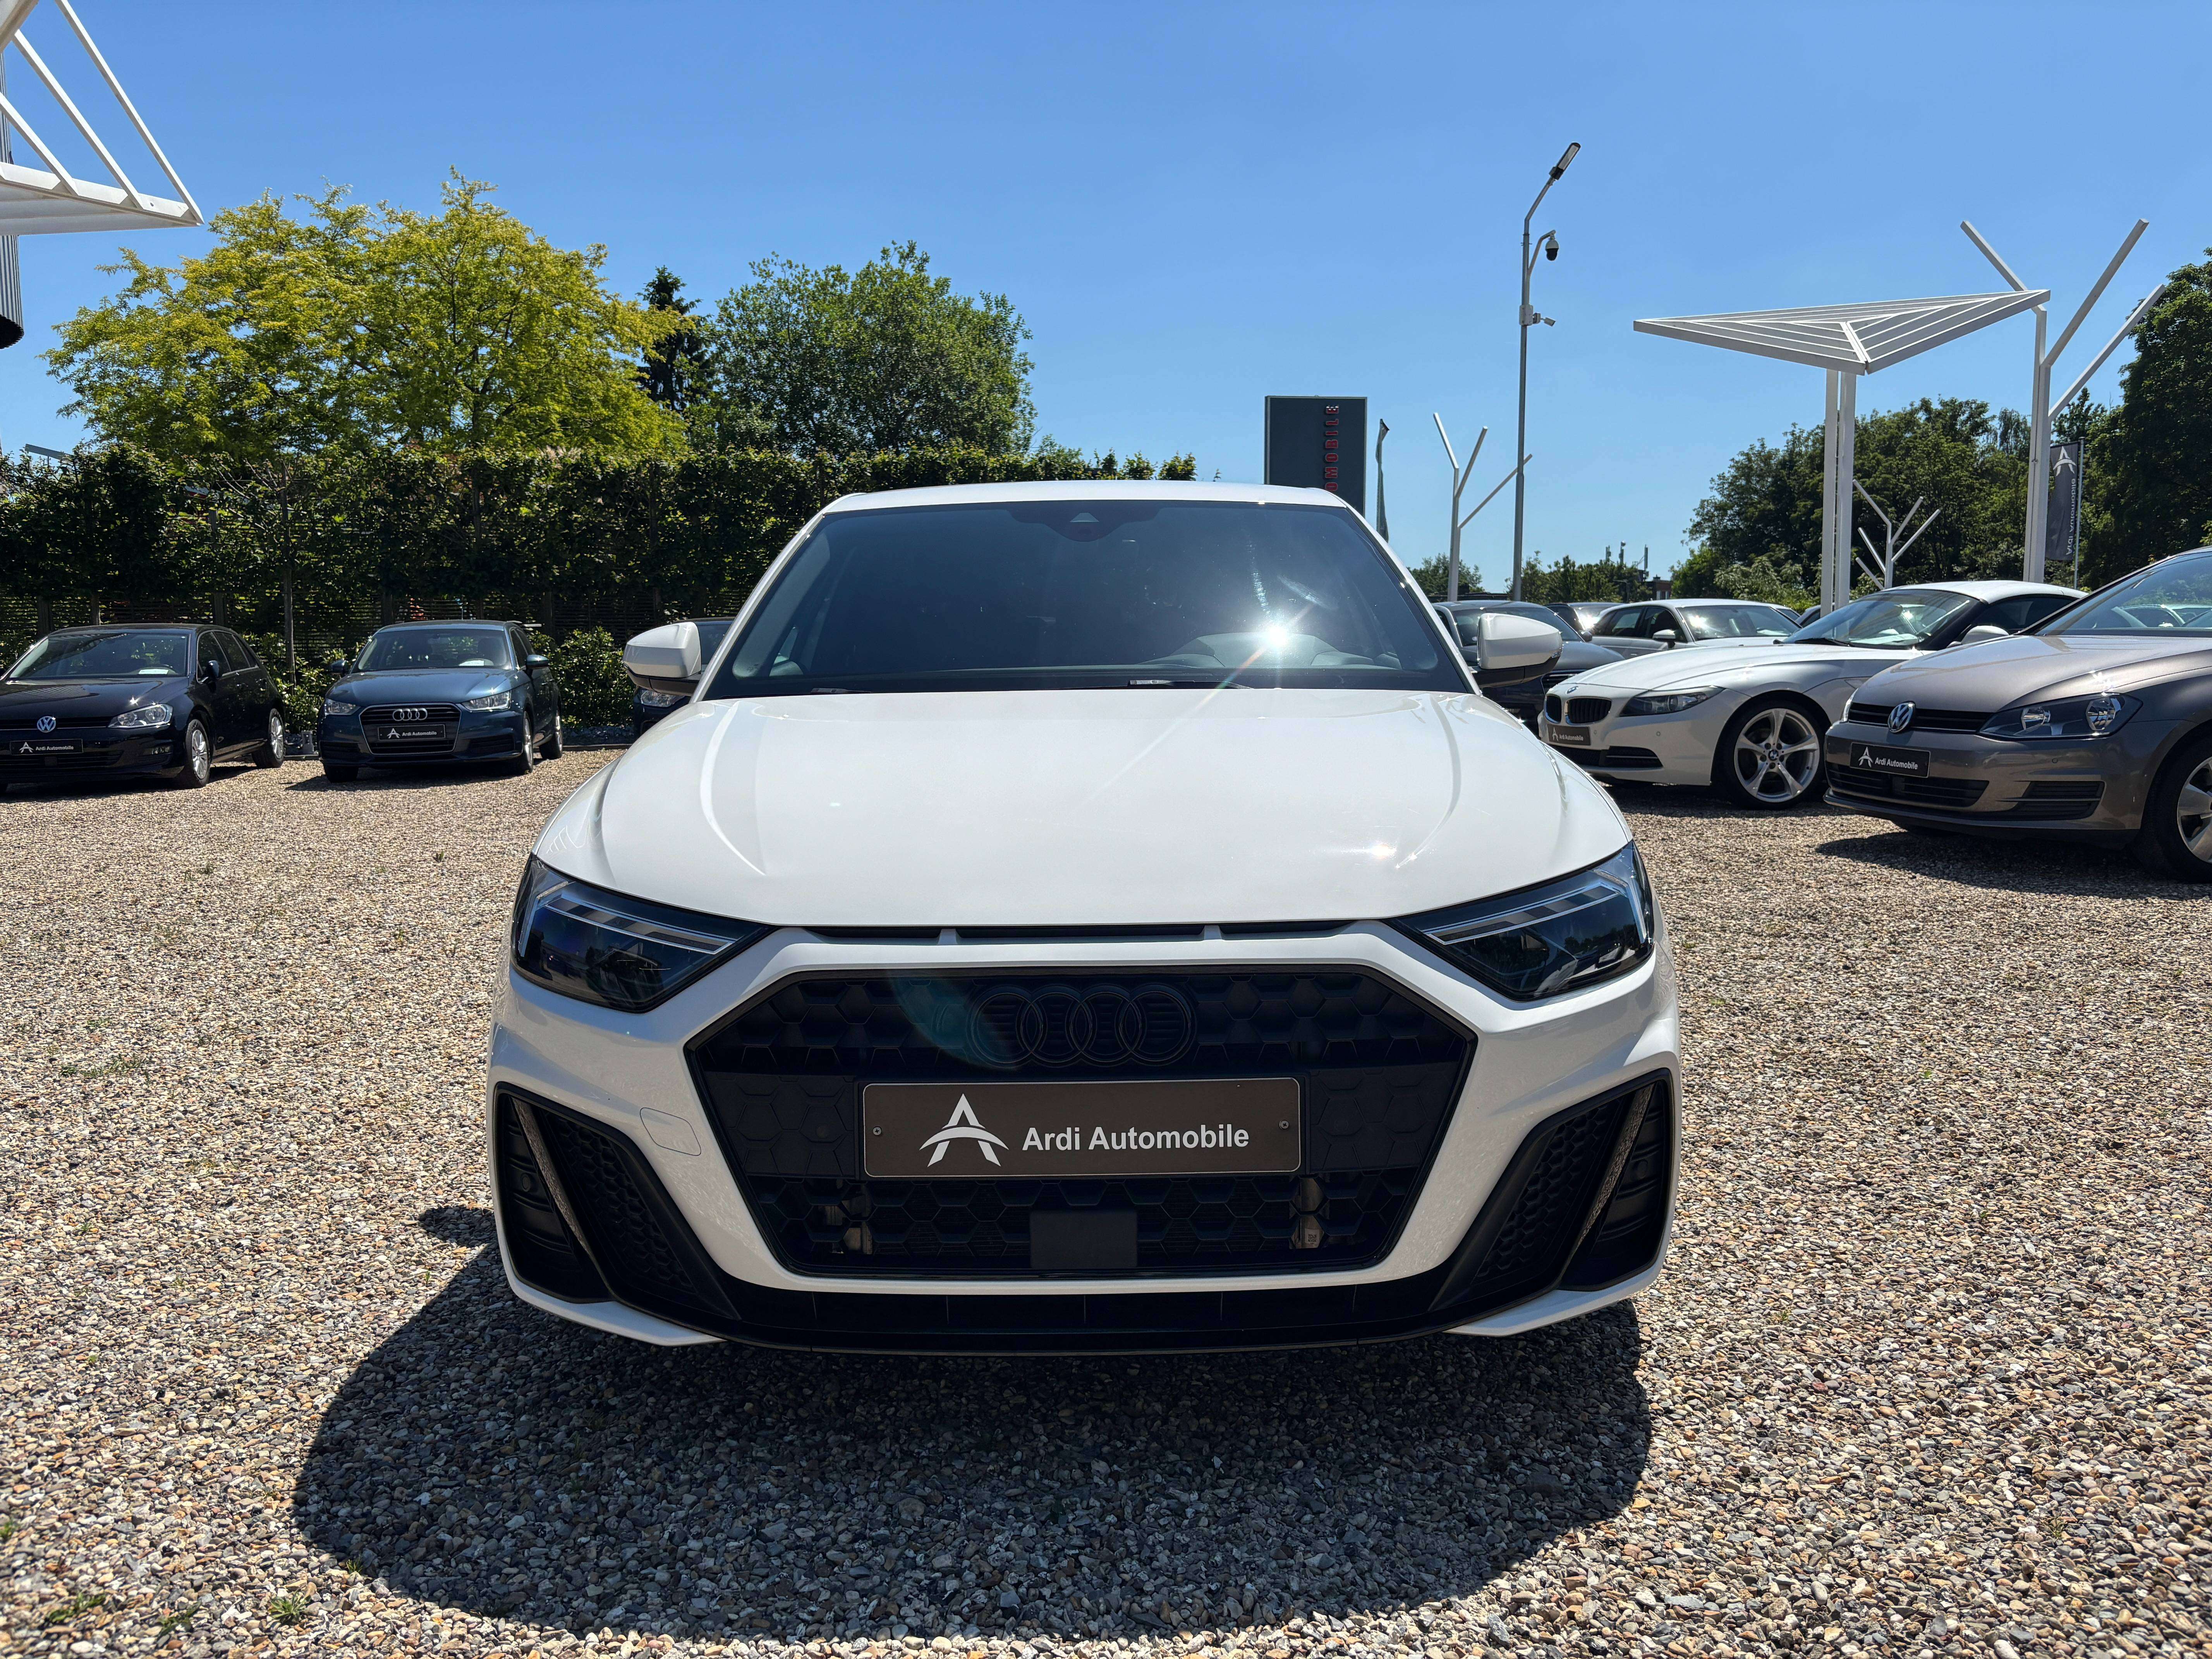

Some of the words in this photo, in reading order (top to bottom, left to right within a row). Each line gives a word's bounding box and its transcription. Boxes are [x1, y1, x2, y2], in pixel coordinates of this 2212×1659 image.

[1875, 757, 1886, 766] Ardi
[1886, 758, 1918, 770] Automobile
[1022, 1127, 1080, 1151] Ardi
[1088, 1124, 1249, 1150] Automobile
